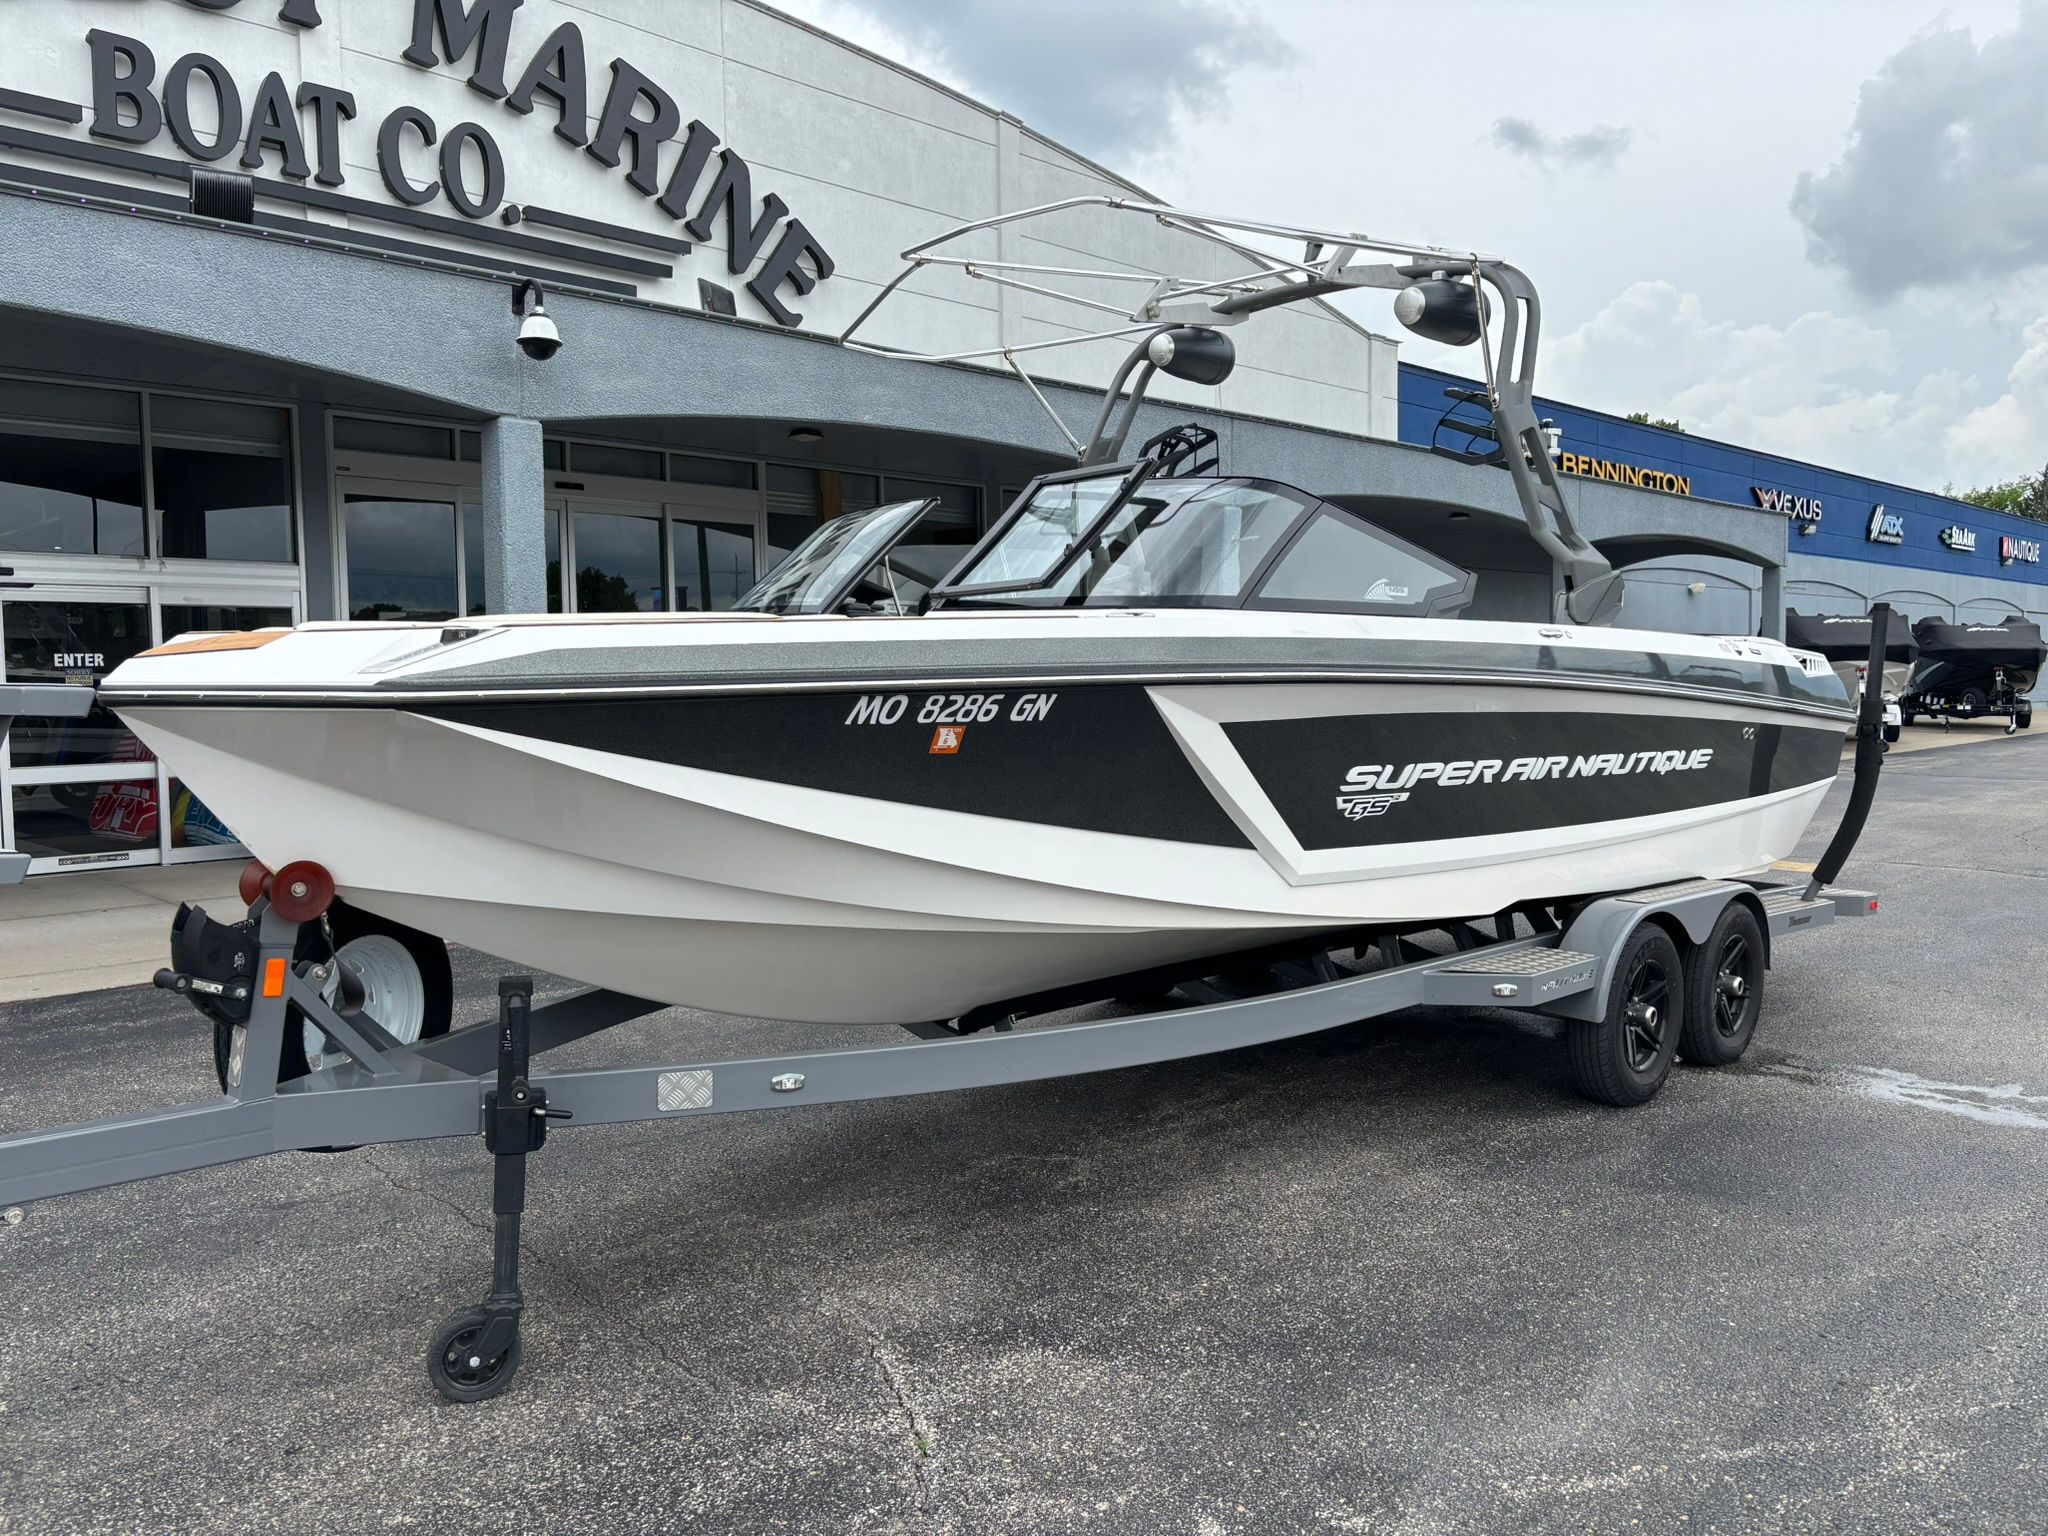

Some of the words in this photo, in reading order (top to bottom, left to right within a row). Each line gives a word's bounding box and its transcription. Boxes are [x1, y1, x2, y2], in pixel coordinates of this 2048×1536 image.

[86, 28, 357, 187] BOAT
[376, 105, 522, 226] CO.
[403, 0, 835, 328] MARINE
[1562, 452, 1691, 496] BENNINGTON
[1773, 489, 1822, 521] VEXUS
[1880, 514, 1904, 537] ATX
[2008, 537, 2040, 562] NAUTIQUE
[54, 653, 104, 667] ENTER
[845, 695, 909, 725] MO
[917, 693, 1005, 724] 8286
[1009, 693, 1058, 721] GN
[1340, 758, 1503, 793] SUPER
[1501, 755, 1570, 783] AIR
[1567, 748, 1714, 779] NAUTIQUE
